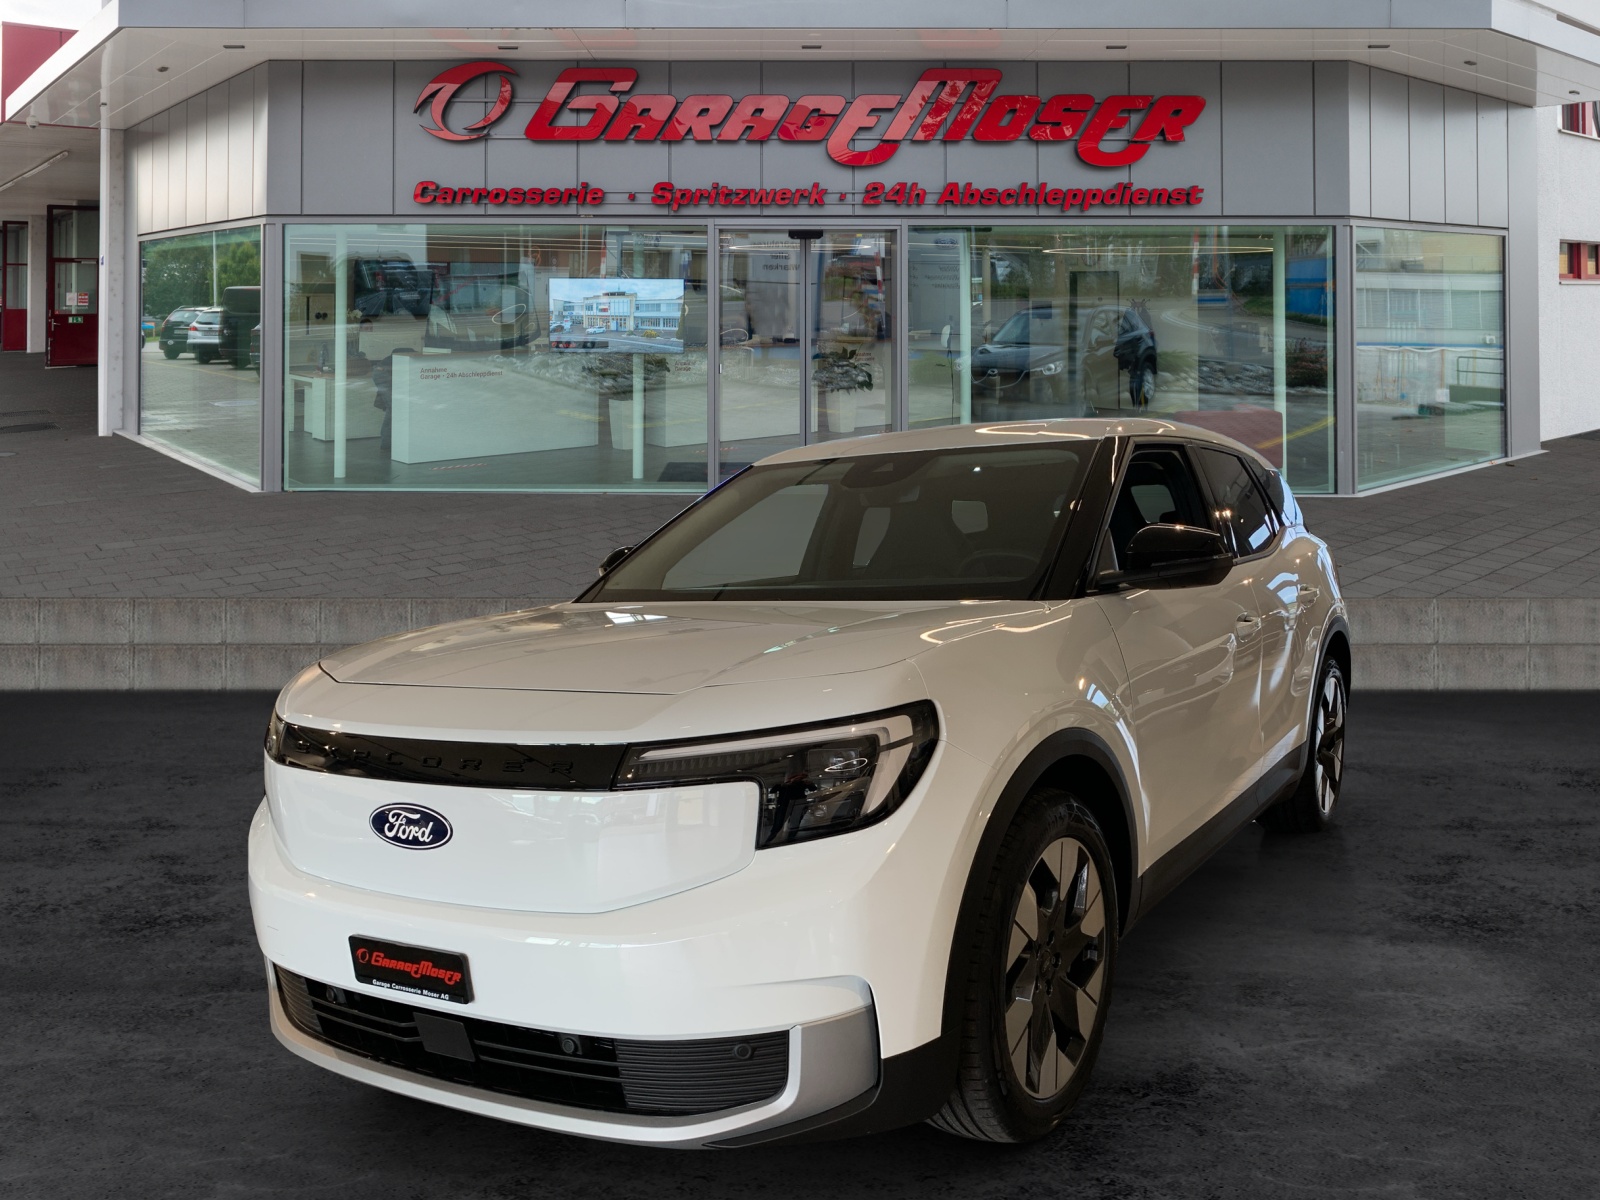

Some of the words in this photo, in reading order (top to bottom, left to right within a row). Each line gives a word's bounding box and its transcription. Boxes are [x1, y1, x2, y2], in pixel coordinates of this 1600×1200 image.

[413, 181, 605, 206] Carrosserie
[651, 181, 827, 211] Spritzwerk
[862, 182, 926, 206] 24h
[937, 182, 1204, 211] Abschleppdienst
[384, 810, 433, 843] Ford
